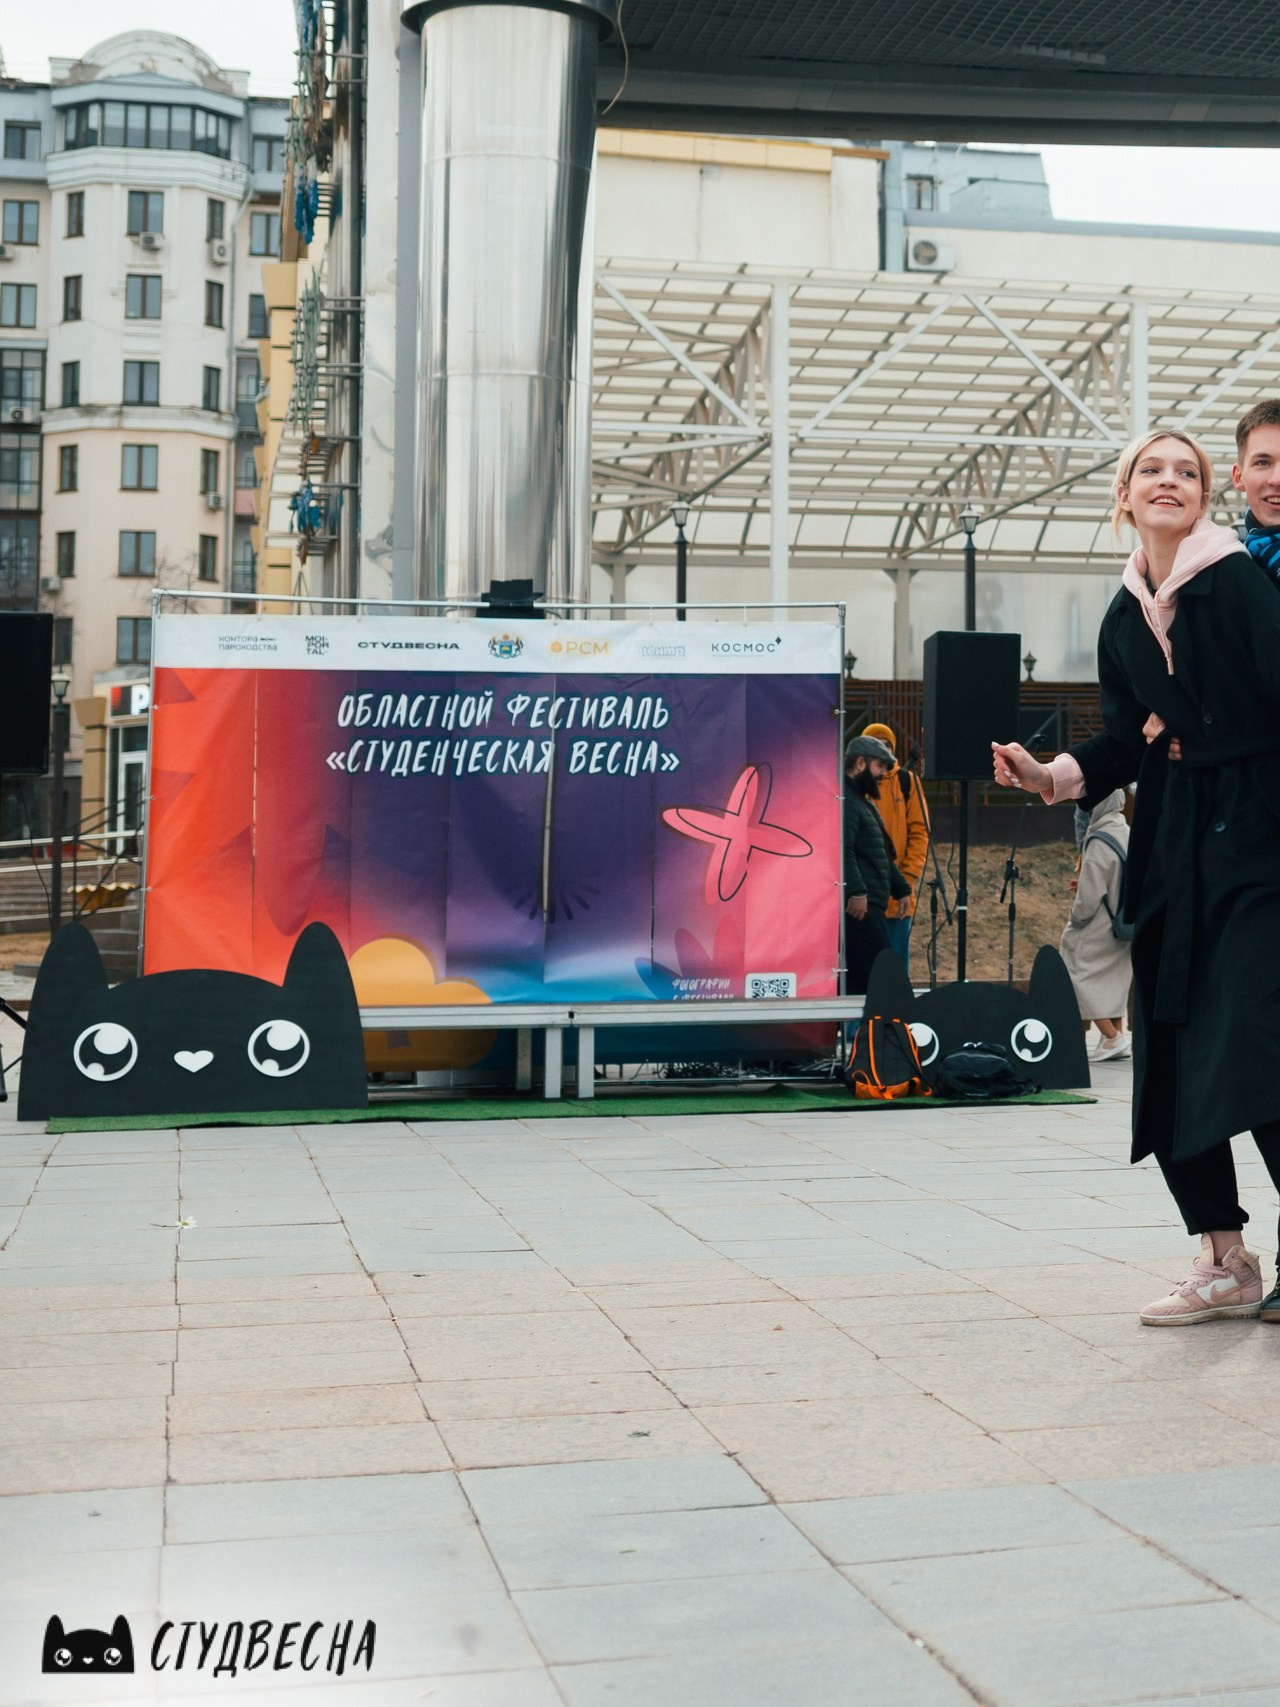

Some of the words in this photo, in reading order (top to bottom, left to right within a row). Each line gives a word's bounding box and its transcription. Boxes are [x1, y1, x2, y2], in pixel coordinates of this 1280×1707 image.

[357, 641, 460, 650] СТУДВЕСНА
[711, 643, 776, 653] КОСМОС
[337, 690, 494, 730] ОБЛАСТНОЙ
[506, 694, 670, 730] ФЕСТИВАЛЬ
[325, 739, 555, 777] «СТУДЕНЧЕСКАЯ
[568, 739, 681, 778] ВЕСНА»
